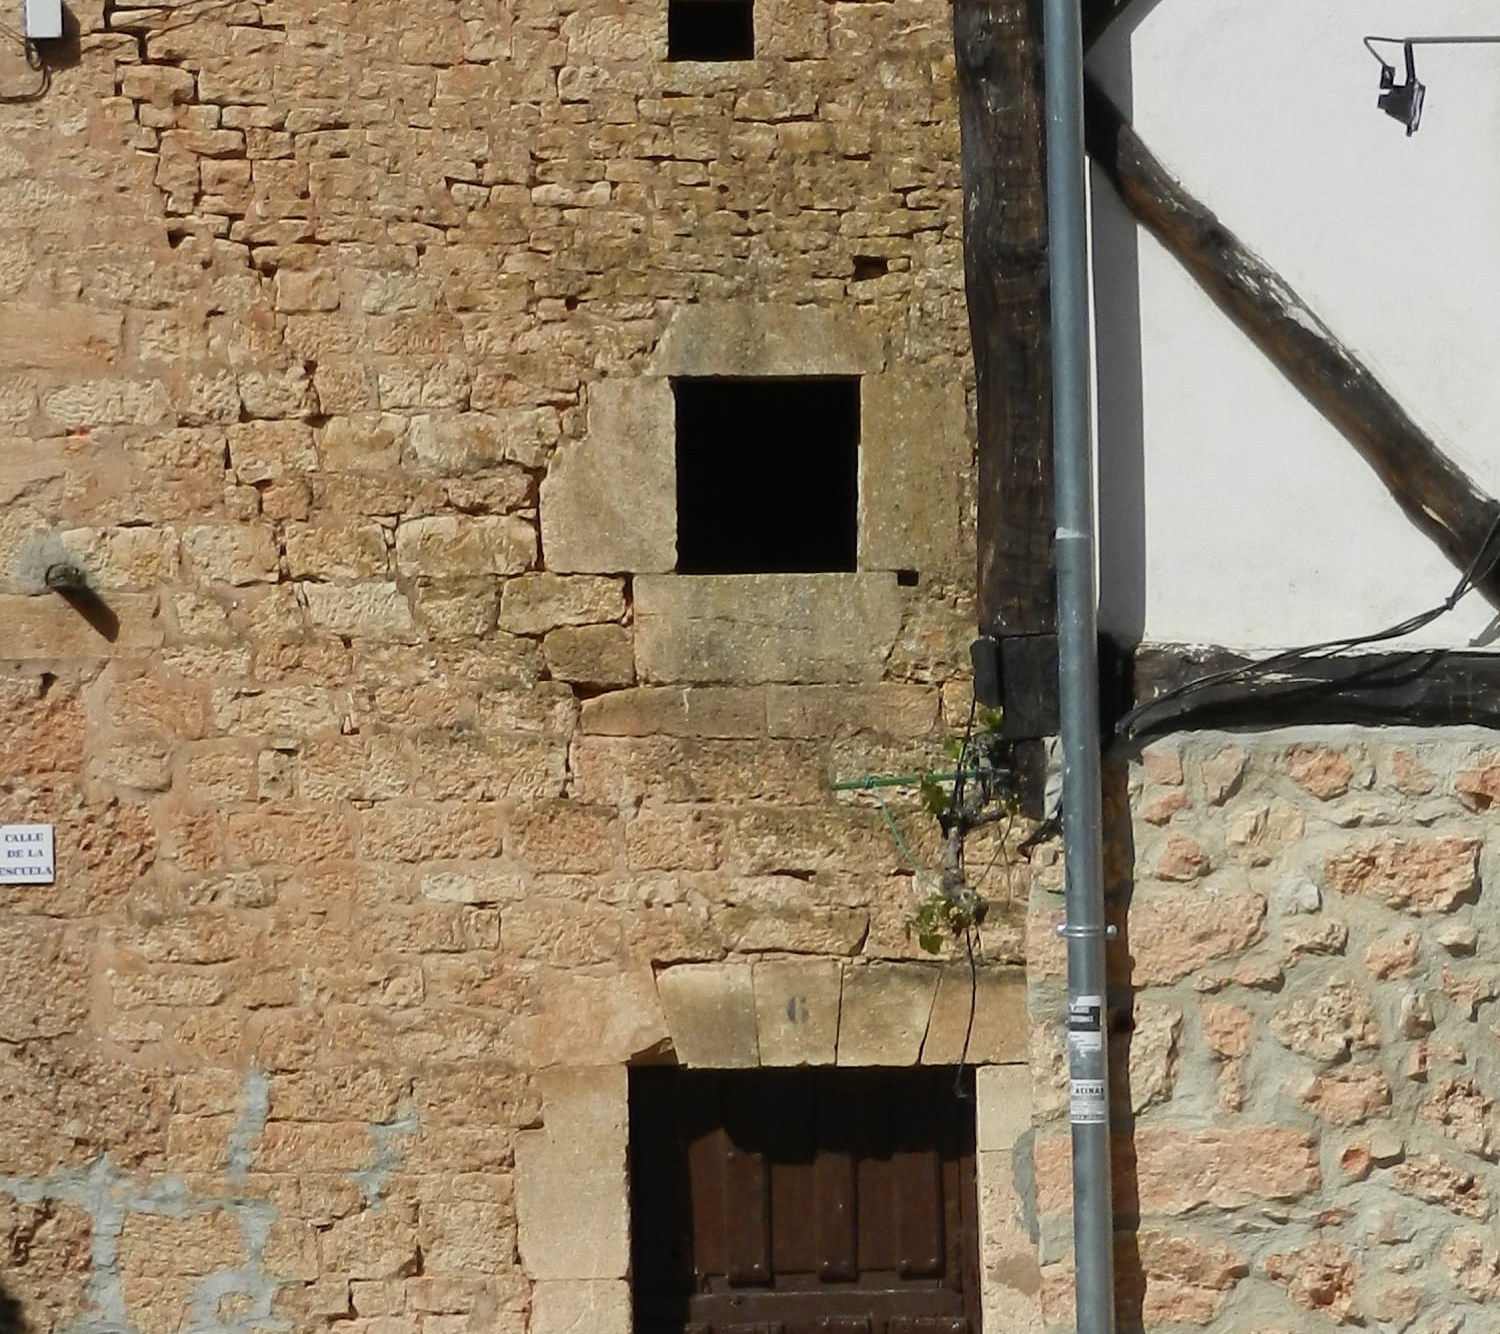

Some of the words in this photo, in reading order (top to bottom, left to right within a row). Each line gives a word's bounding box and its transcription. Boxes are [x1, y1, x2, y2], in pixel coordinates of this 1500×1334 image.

[5, 833, 44, 842] CALLE
[7, 850, 24, 858] DE
[28, 849, 44, 857] LA
[0, 867, 52, 876] ESCUELA
[786, 996, 809, 1024] 6
